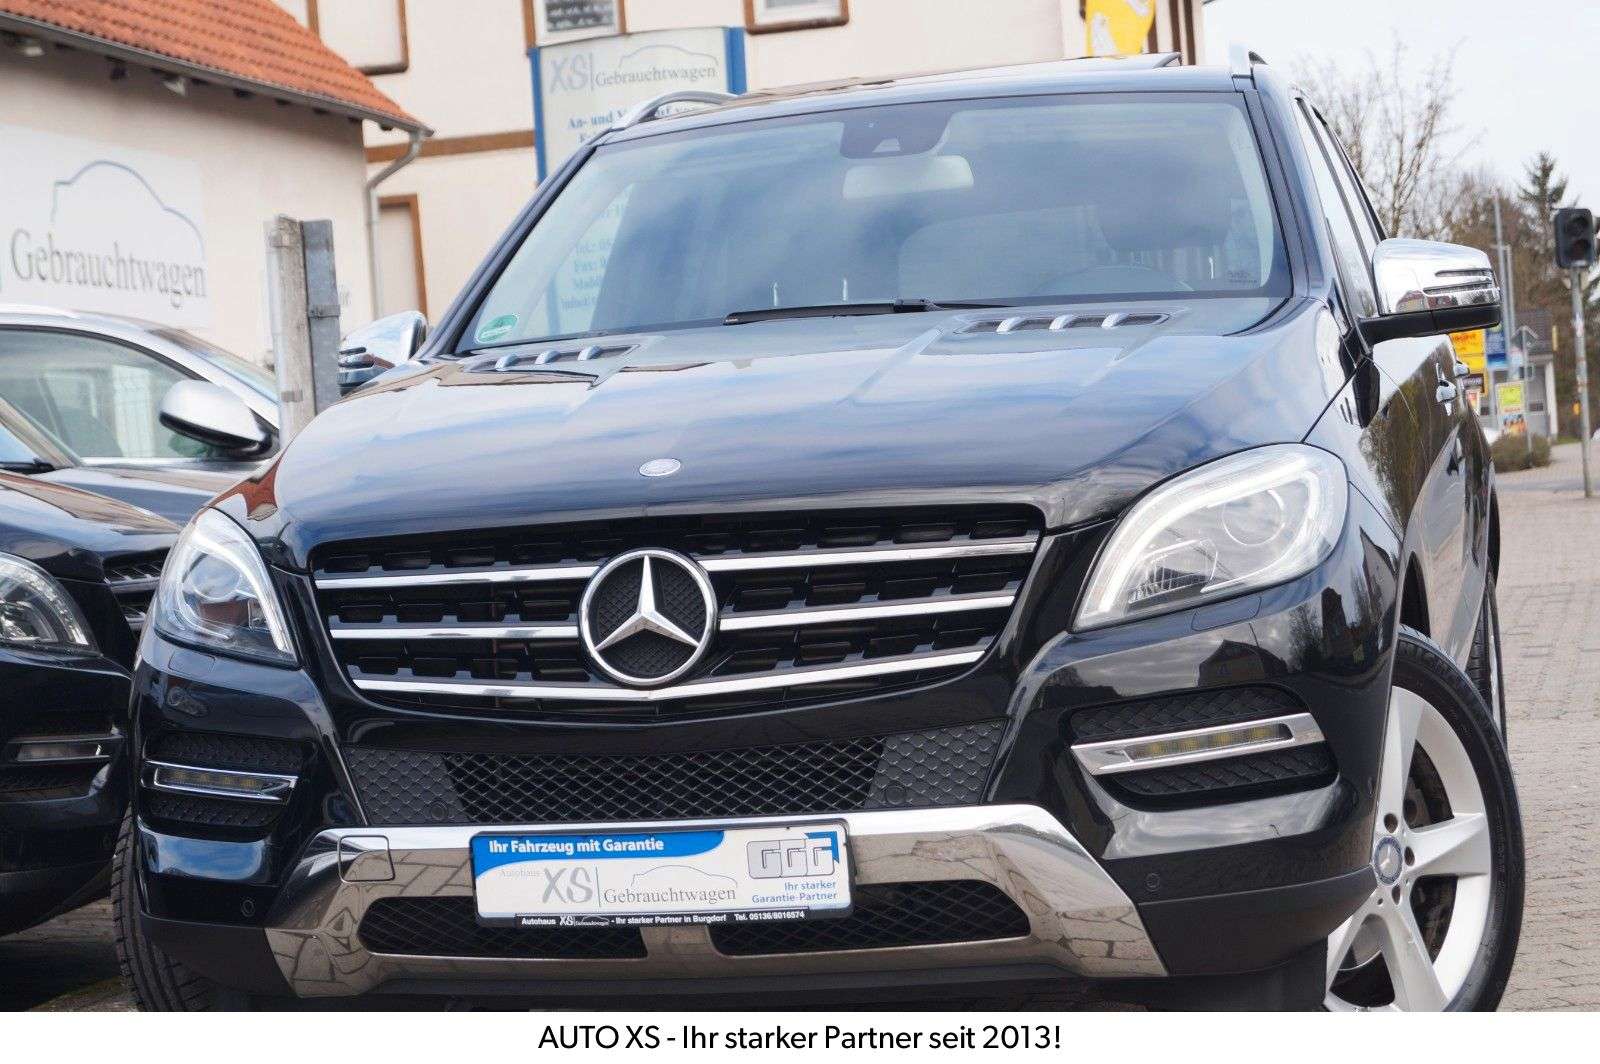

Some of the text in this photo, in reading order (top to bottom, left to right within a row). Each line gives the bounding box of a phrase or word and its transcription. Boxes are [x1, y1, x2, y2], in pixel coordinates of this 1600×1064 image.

[549, 55, 716, 94] XS Gebrauchtwagen
[591, 110, 613, 125] und
[10, 227, 207, 309] Gebrauchtwagen
[488, 838, 664, 855] Ihr Fahrzeug mit Garantie
[542, 866, 593, 904] XS
[604, 887, 736, 905] Gebrauchtwagen
[784, 881, 836, 891] Ihr starker
[521, 917, 556, 925] Autohaus
[560, 915, 573, 926] XS
[627, 916, 653, 924] starker
[654, 915, 683, 924] Partner
[684, 914, 691, 923] in
[692, 914, 727, 924] Burgdorf
